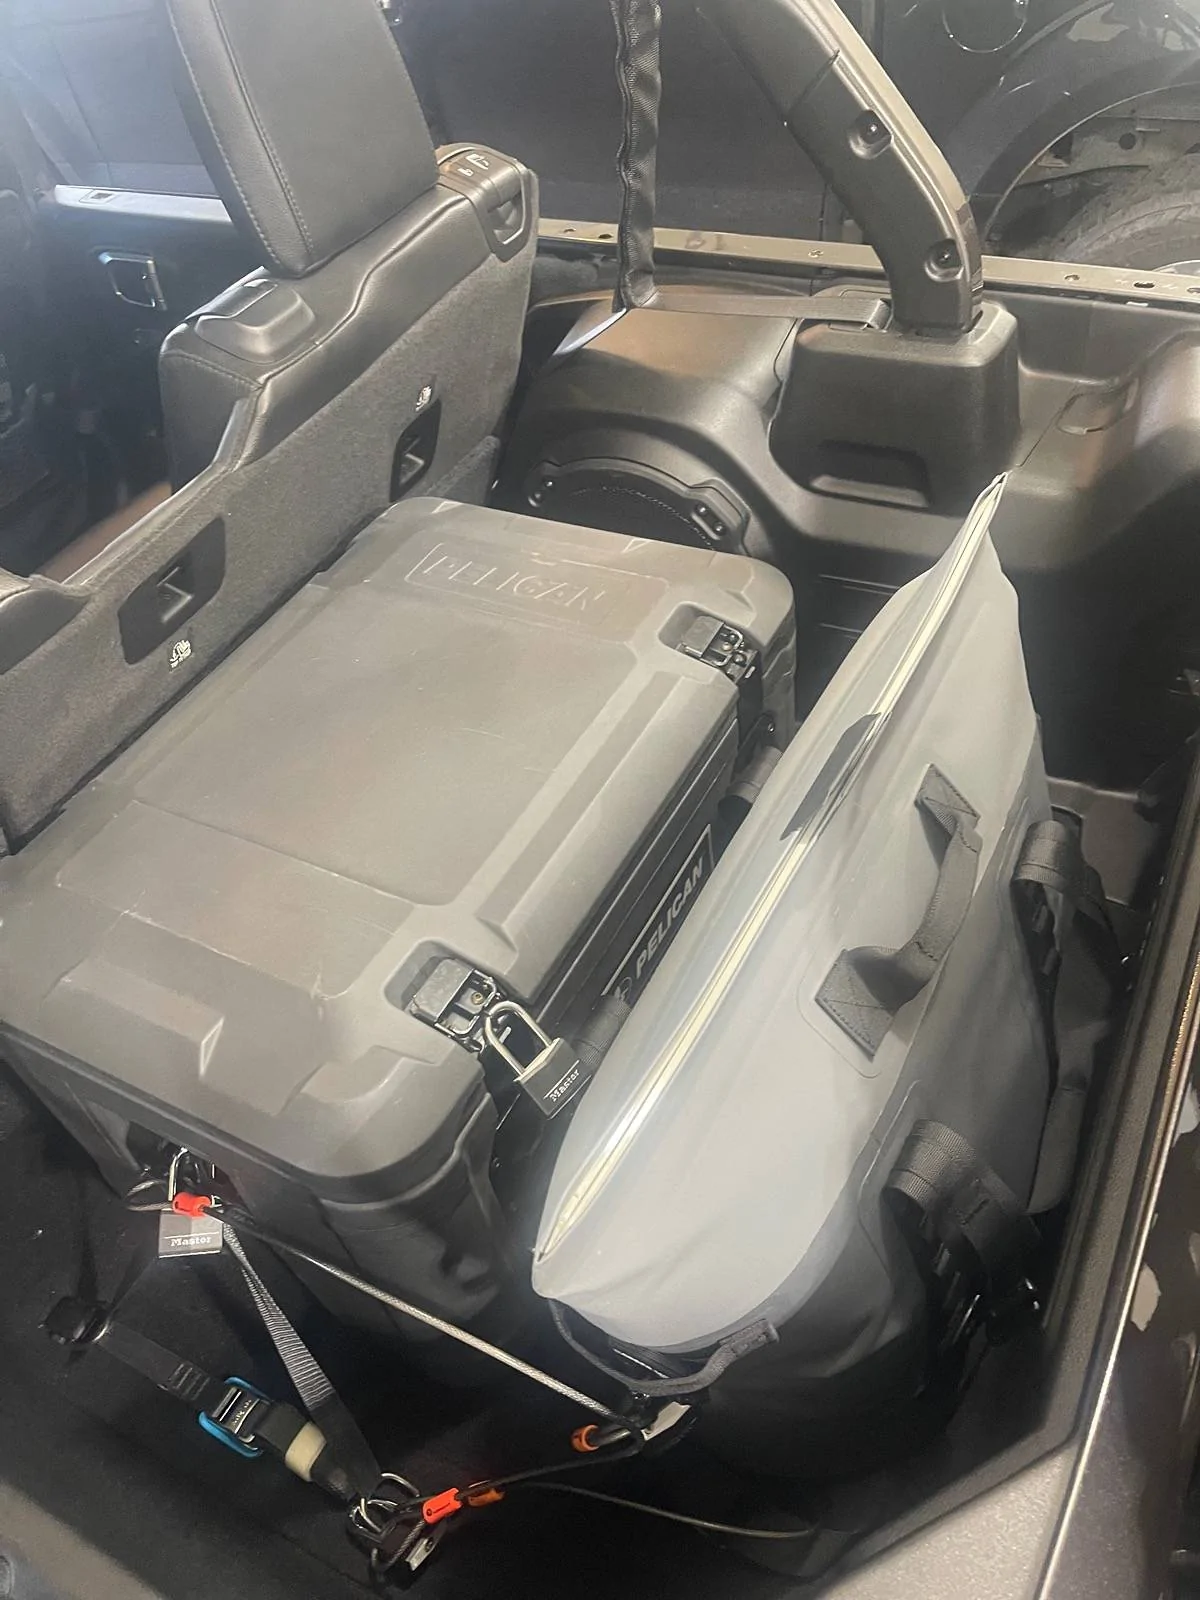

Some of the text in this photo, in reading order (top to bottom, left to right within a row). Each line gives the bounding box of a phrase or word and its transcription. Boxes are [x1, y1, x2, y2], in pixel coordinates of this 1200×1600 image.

[422, 552, 607, 612] PELICAN
[635, 856, 704, 980] PELICAN
[549, 1069, 580, 1102] Master
[170, 1235, 212, 1247] Master
